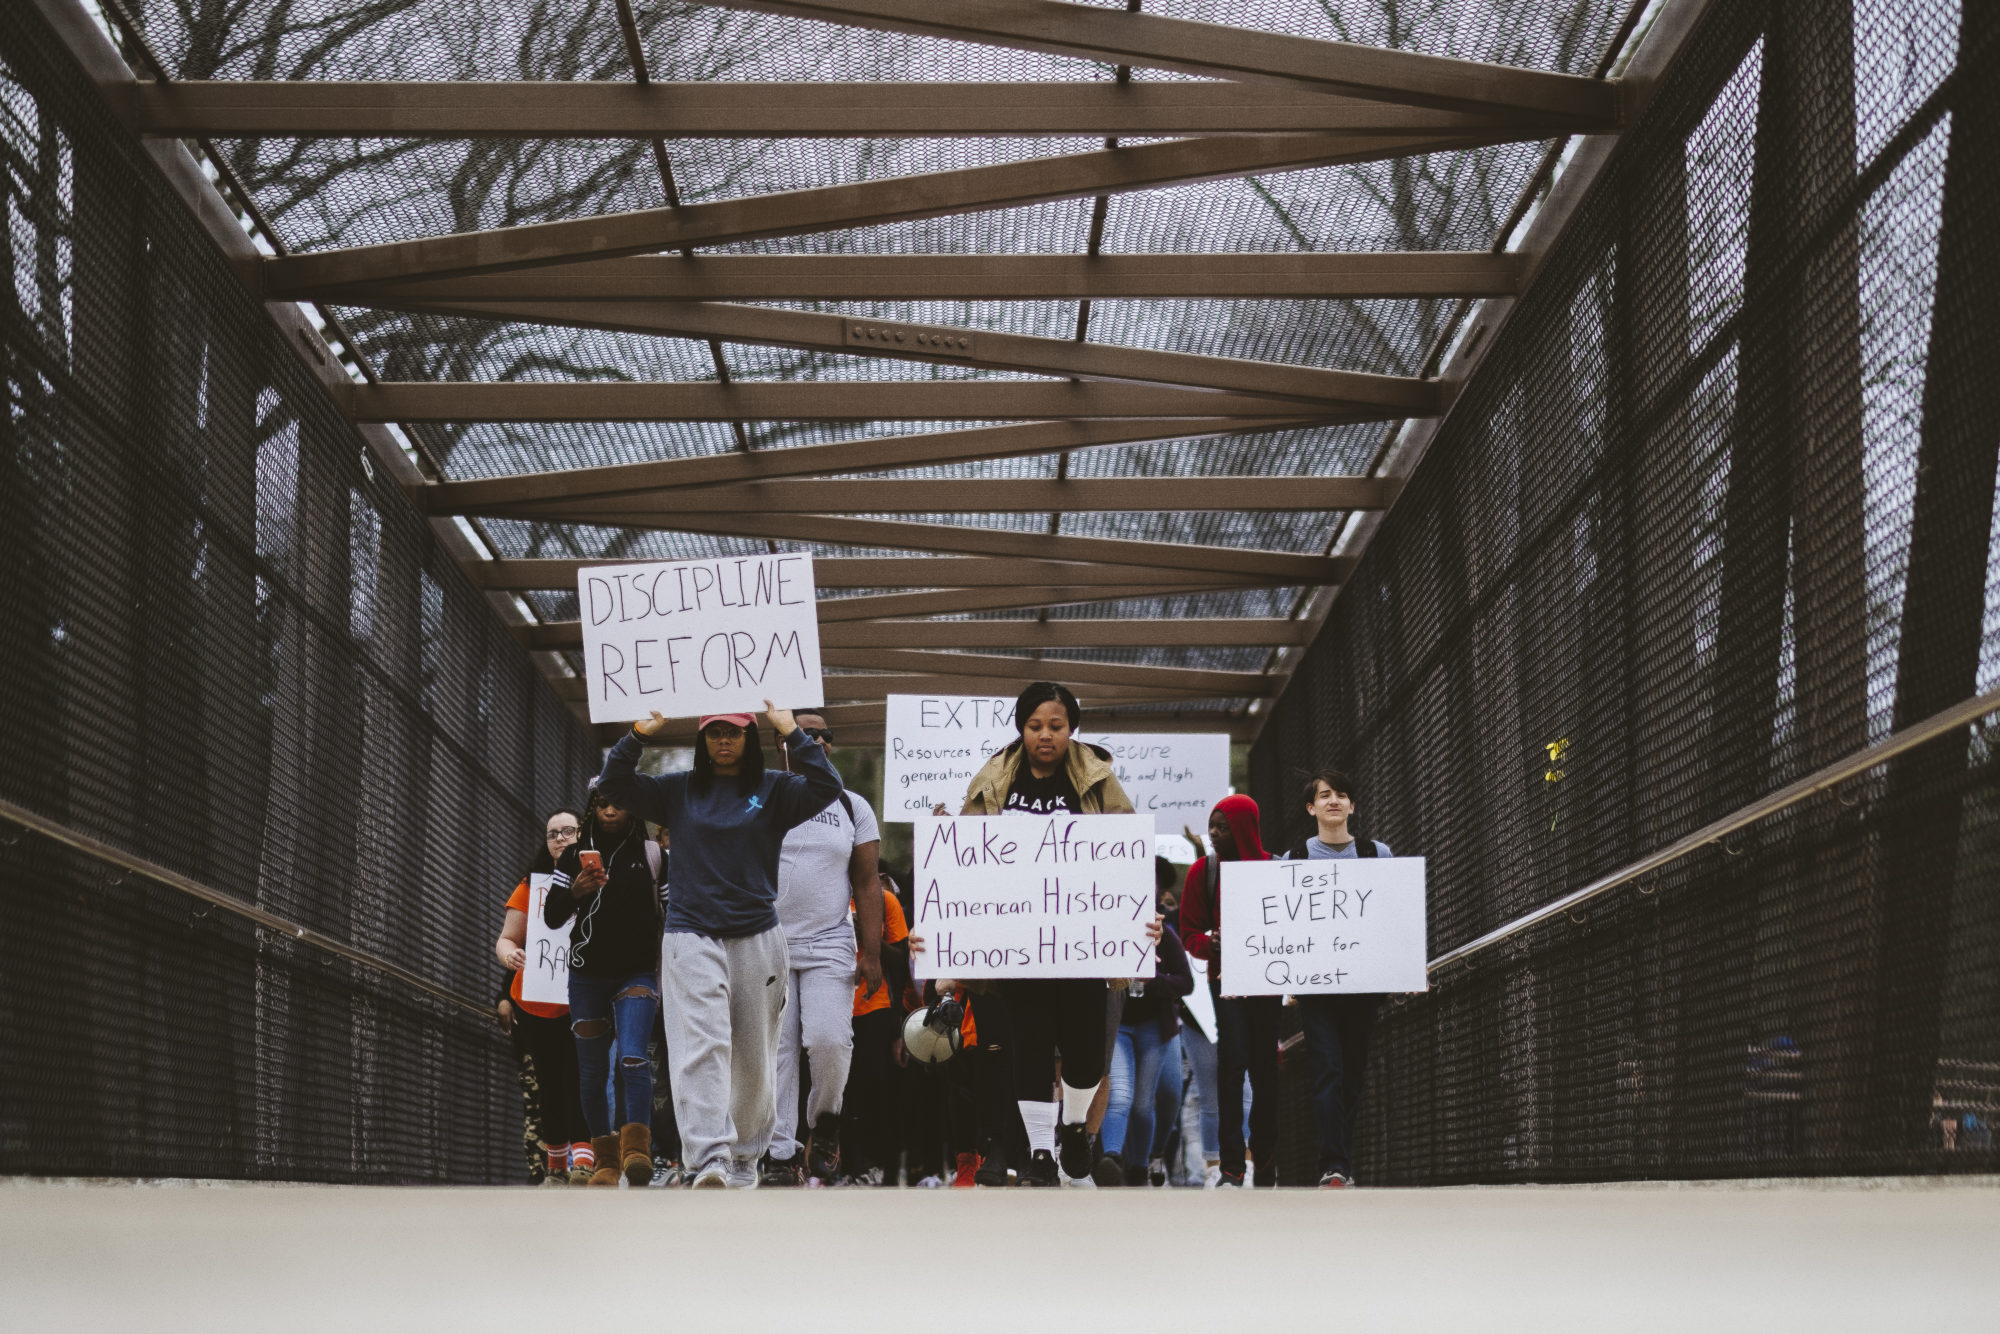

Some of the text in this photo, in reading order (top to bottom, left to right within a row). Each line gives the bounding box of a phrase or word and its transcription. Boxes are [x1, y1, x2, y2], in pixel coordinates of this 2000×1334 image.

[588, 557, 806, 627] DISCIPLINE
[601, 630, 807, 702] REFORM
[892, 737, 971, 760] Resources
[1097, 736, 1171, 760] Secure
[900, 768, 972, 789] generation
[1137, 768, 1157, 781] and
[1162, 766, 1193, 783] High
[904, 795, 948, 811] colle
[1008, 792, 1067, 811] BLACK
[923, 818, 1146, 869] Make African
[1280, 863, 1340, 888] Test
[920, 877, 1148, 923] American History
[1261, 889, 1373, 925] EVERY
[936, 925, 1155, 973] Honors History
[1245, 935, 1360, 956] Student for
[1264, 960, 1349, 986] Quest
